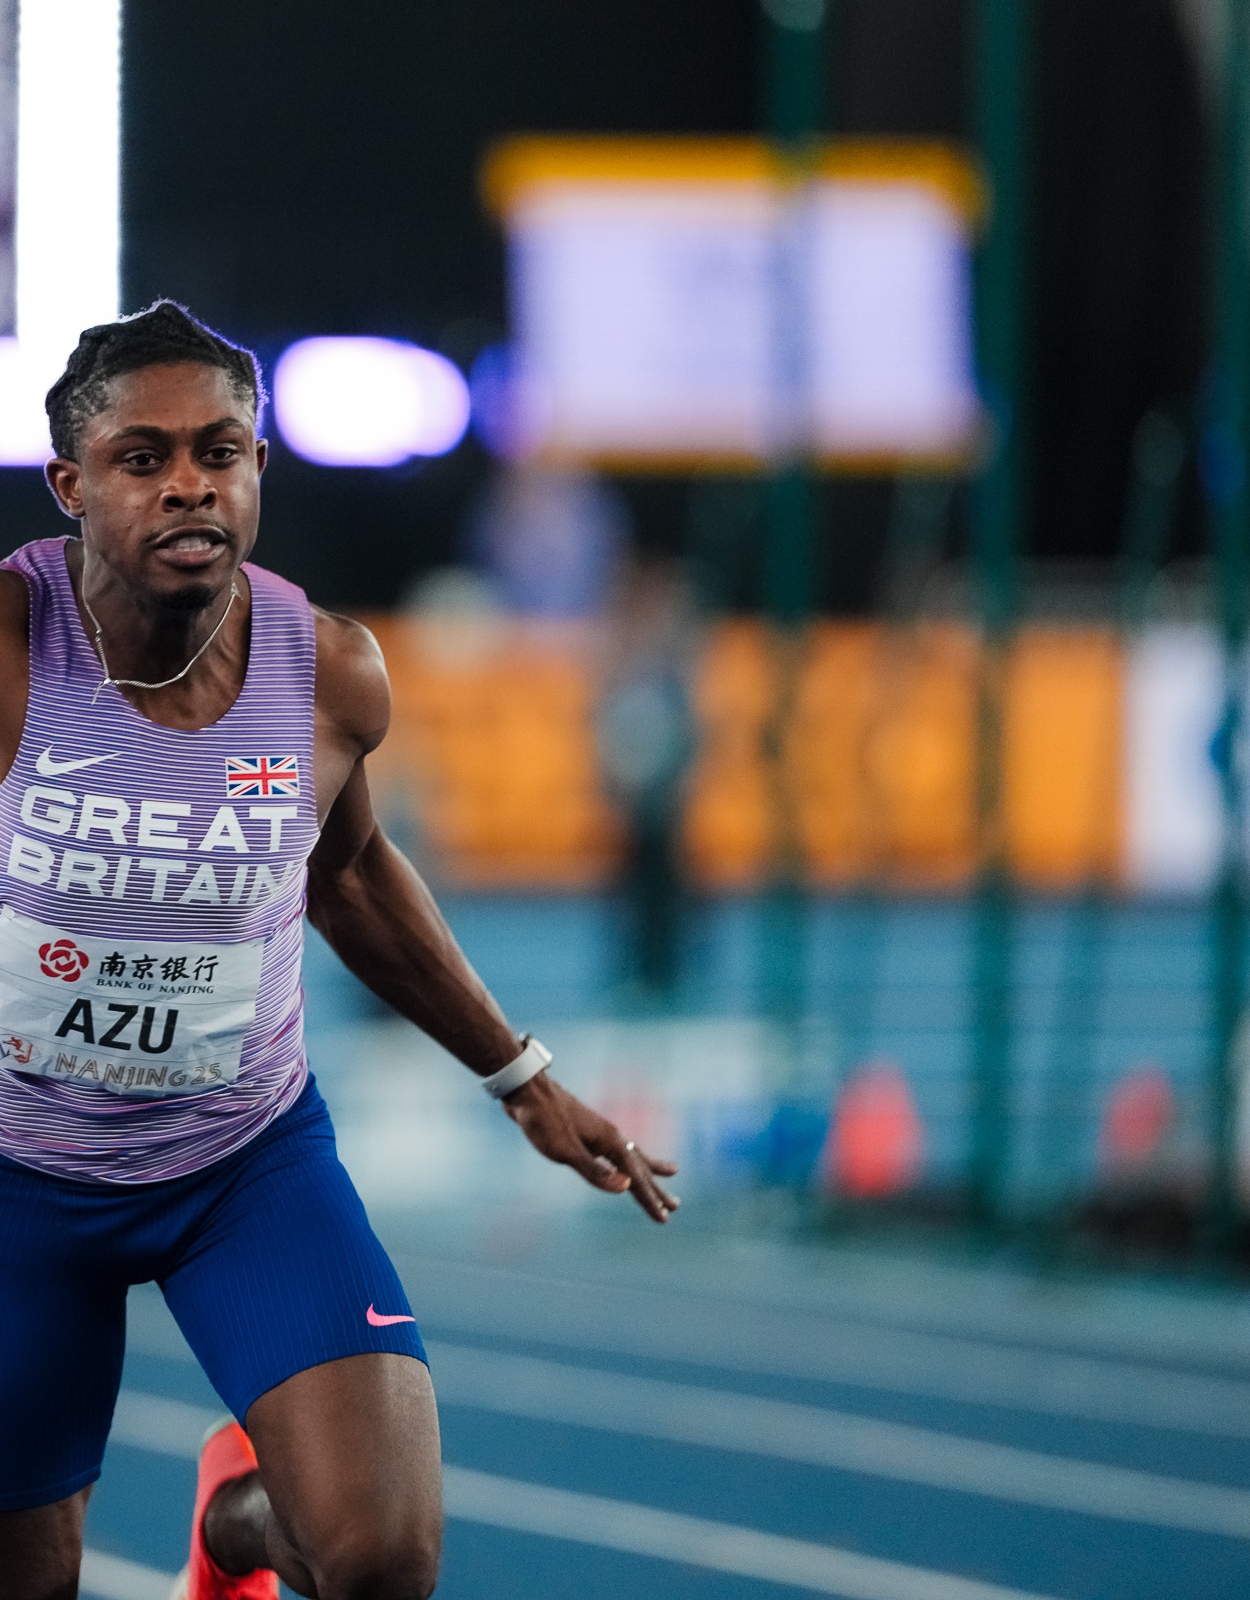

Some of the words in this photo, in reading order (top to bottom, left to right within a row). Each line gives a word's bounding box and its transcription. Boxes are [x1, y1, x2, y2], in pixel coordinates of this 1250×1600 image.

[20, 785, 298, 854] GREAT
[7, 834, 295, 905] BRITAIN
[96, 978, 134, 990] BANK
[138, 982, 155, 991] OF
[159, 985, 215, 995] NANJING
[99, 951, 220, 983] 南京银行
[54, 998, 180, 1055] AZU
